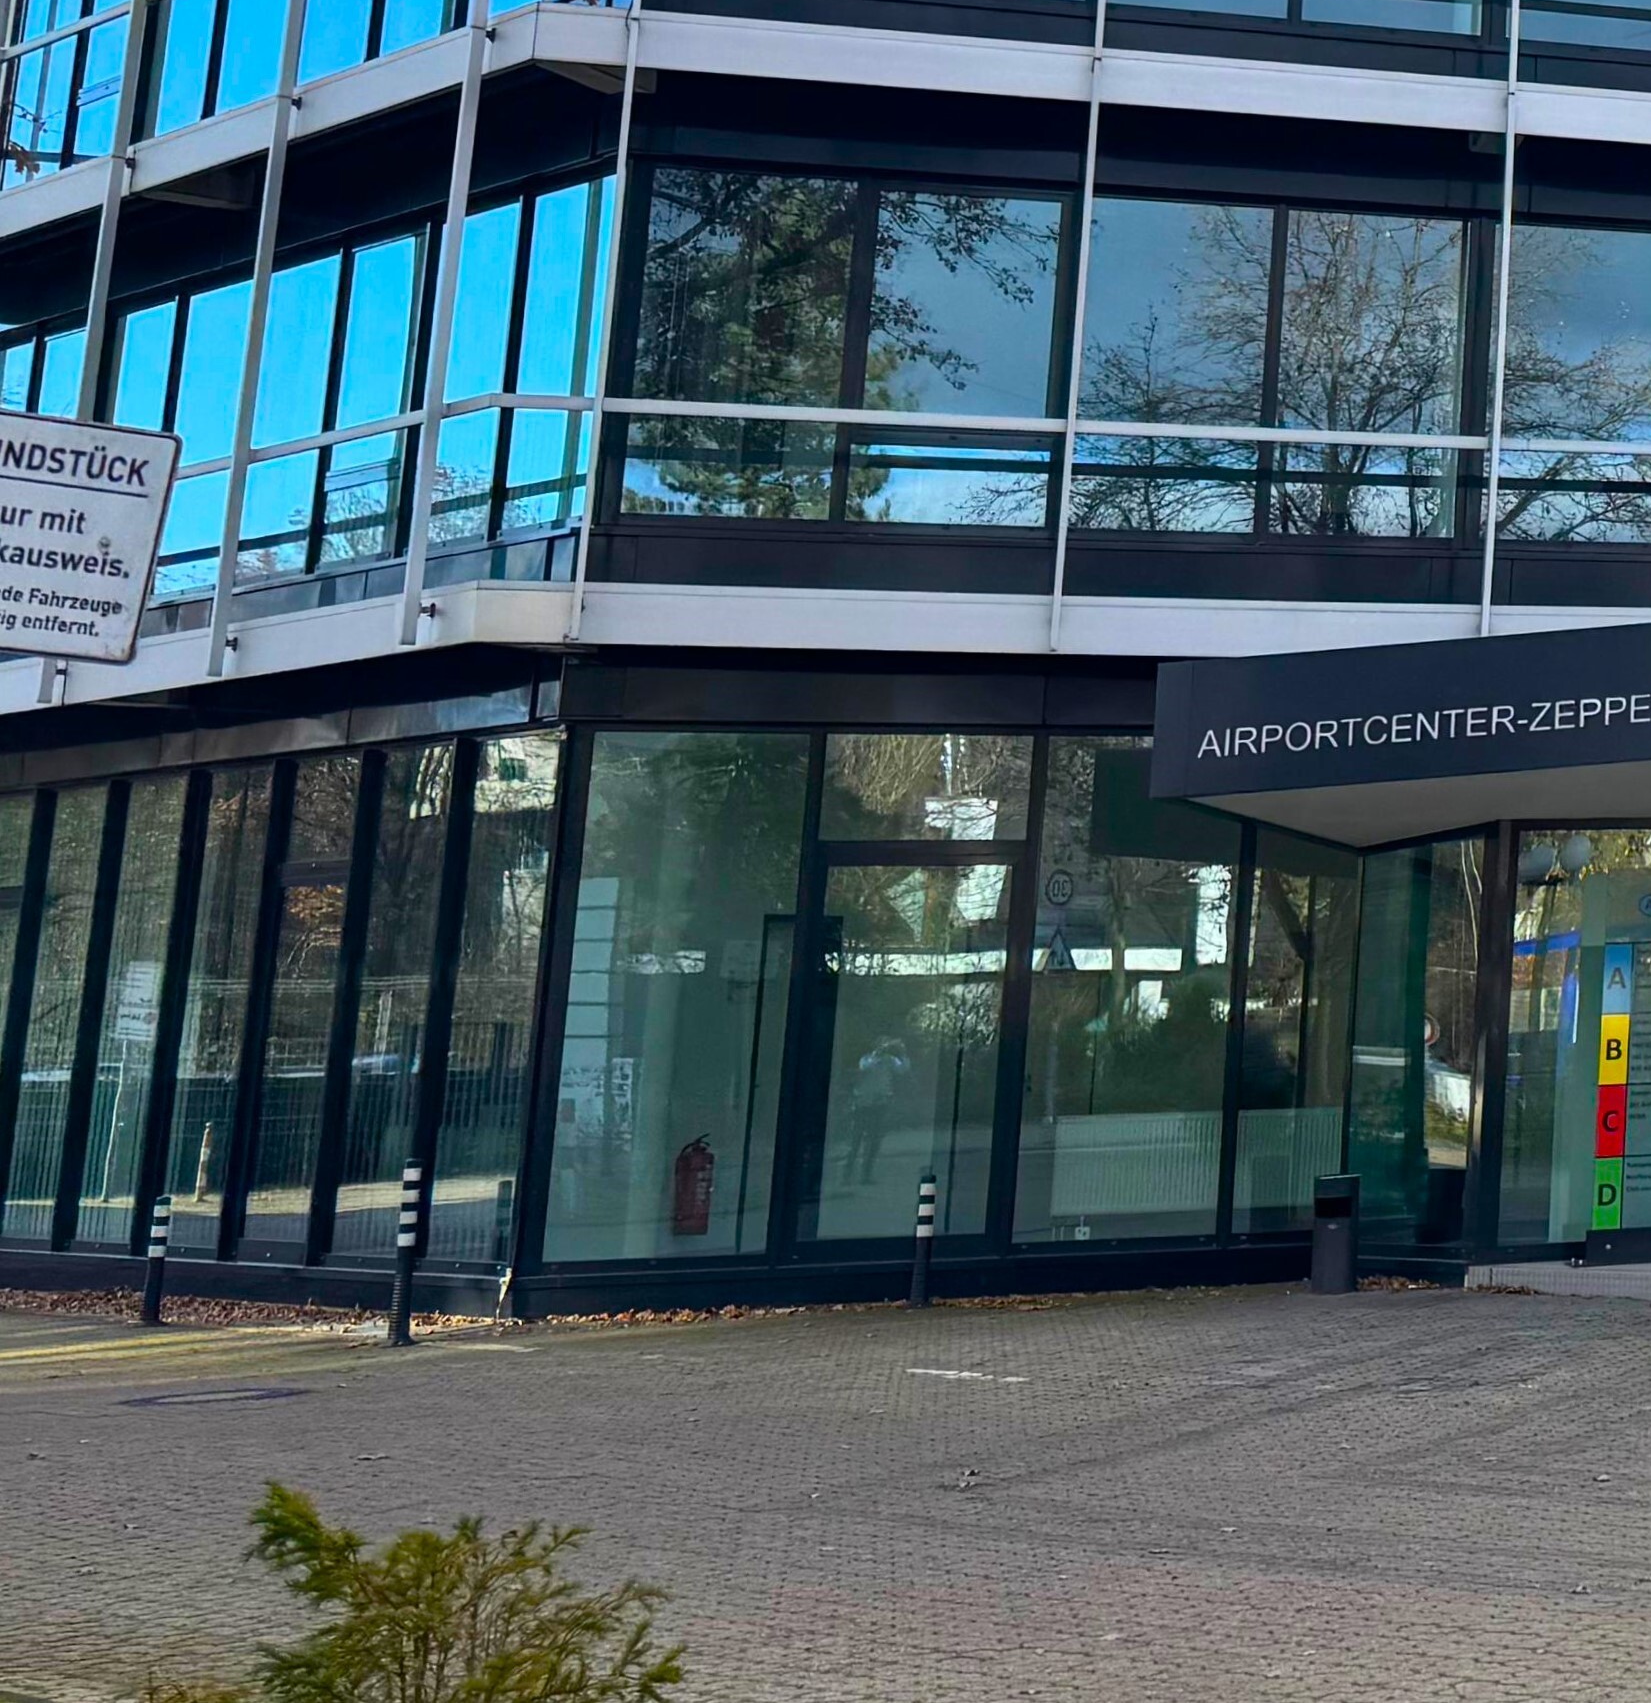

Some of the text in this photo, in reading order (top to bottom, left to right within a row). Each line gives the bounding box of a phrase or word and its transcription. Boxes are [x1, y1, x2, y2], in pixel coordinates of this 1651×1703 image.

[0, 439, 149, 487] NDSTÜCK
[39, 508, 86, 535] mit
[0, 585, 123, 617] de Fahrzeuge
[21, 614, 99, 637] entfernt.
[1608, 967, 1626, 989] A
[1605, 1038, 1622, 1060] B
[1601, 1110, 1619, 1132] C
[1597, 1184, 1617, 1206] D
